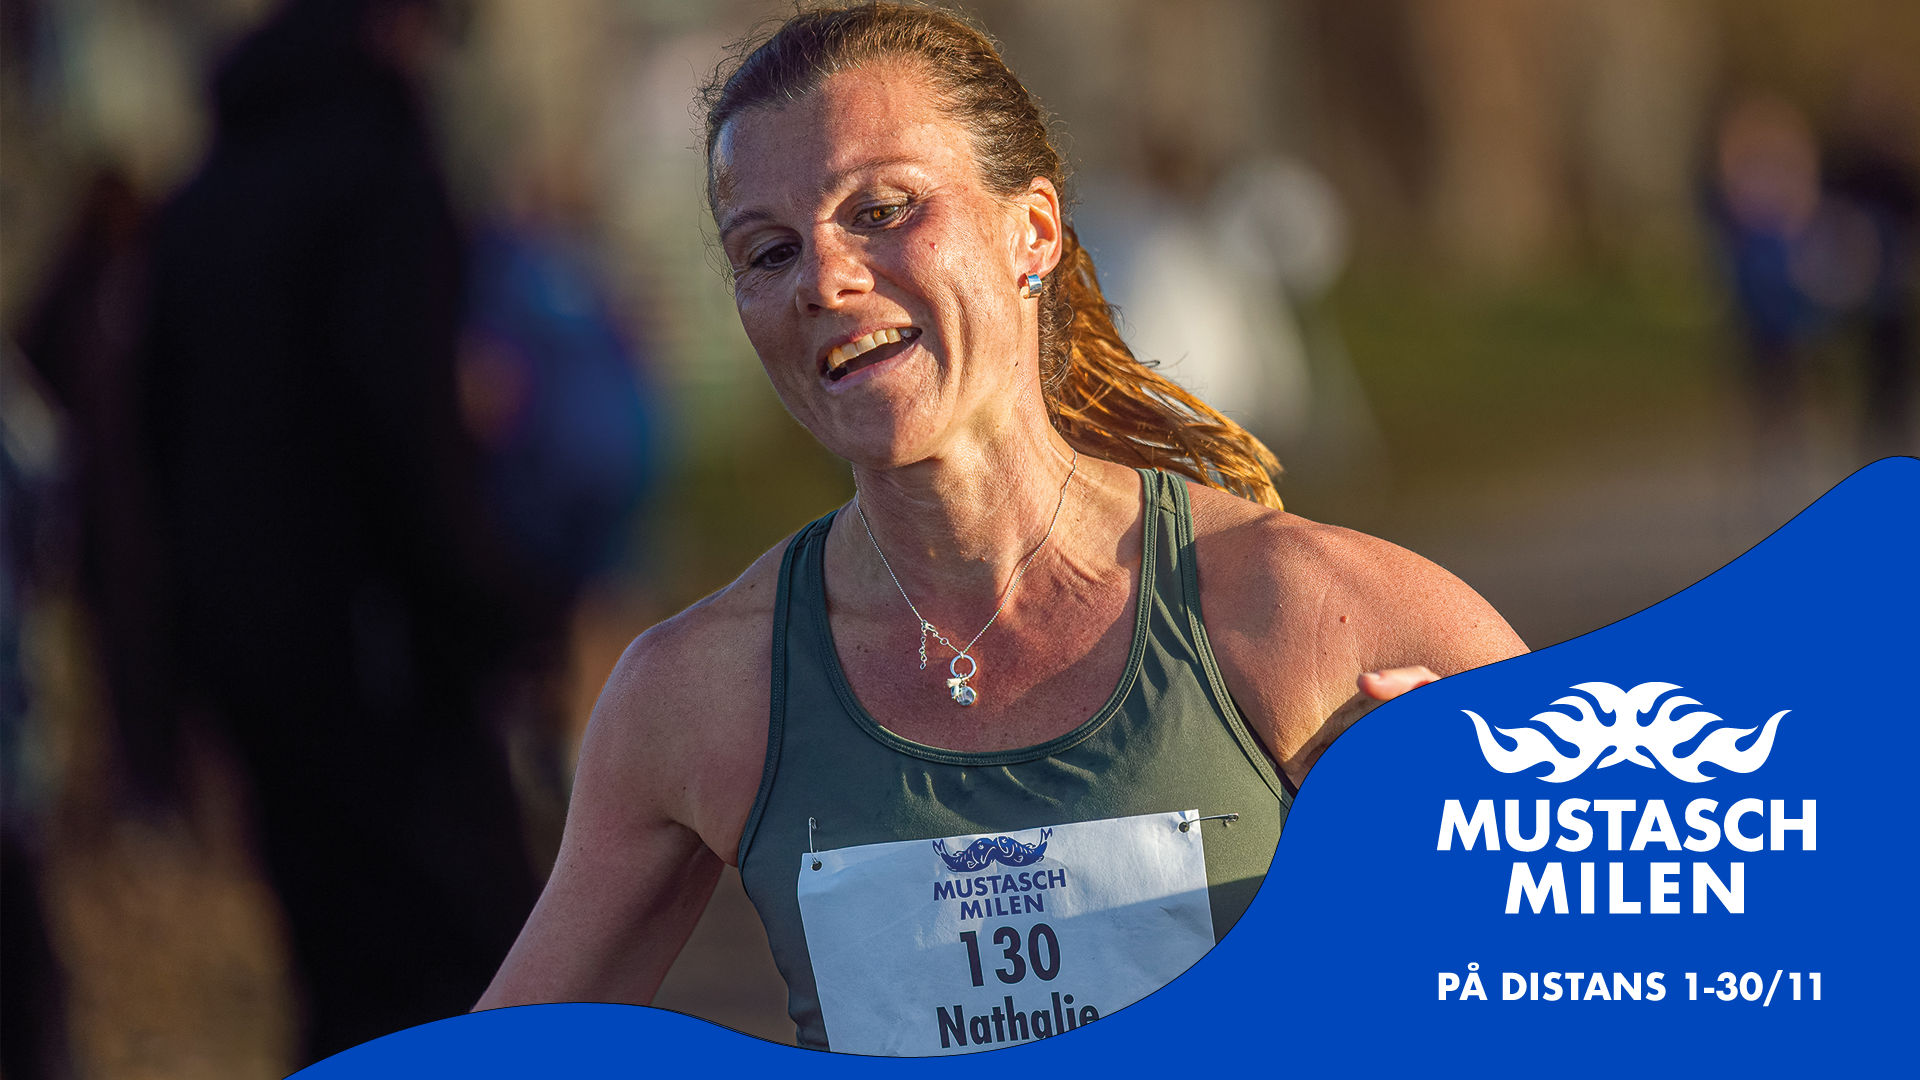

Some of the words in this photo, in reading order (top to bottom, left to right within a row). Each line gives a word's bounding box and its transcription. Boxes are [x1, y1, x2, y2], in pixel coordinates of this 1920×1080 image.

[933, 869, 1066, 901] MUSTASCH
[960, 894, 1044, 920] MILEN
[959, 922, 1061, 987] 130
